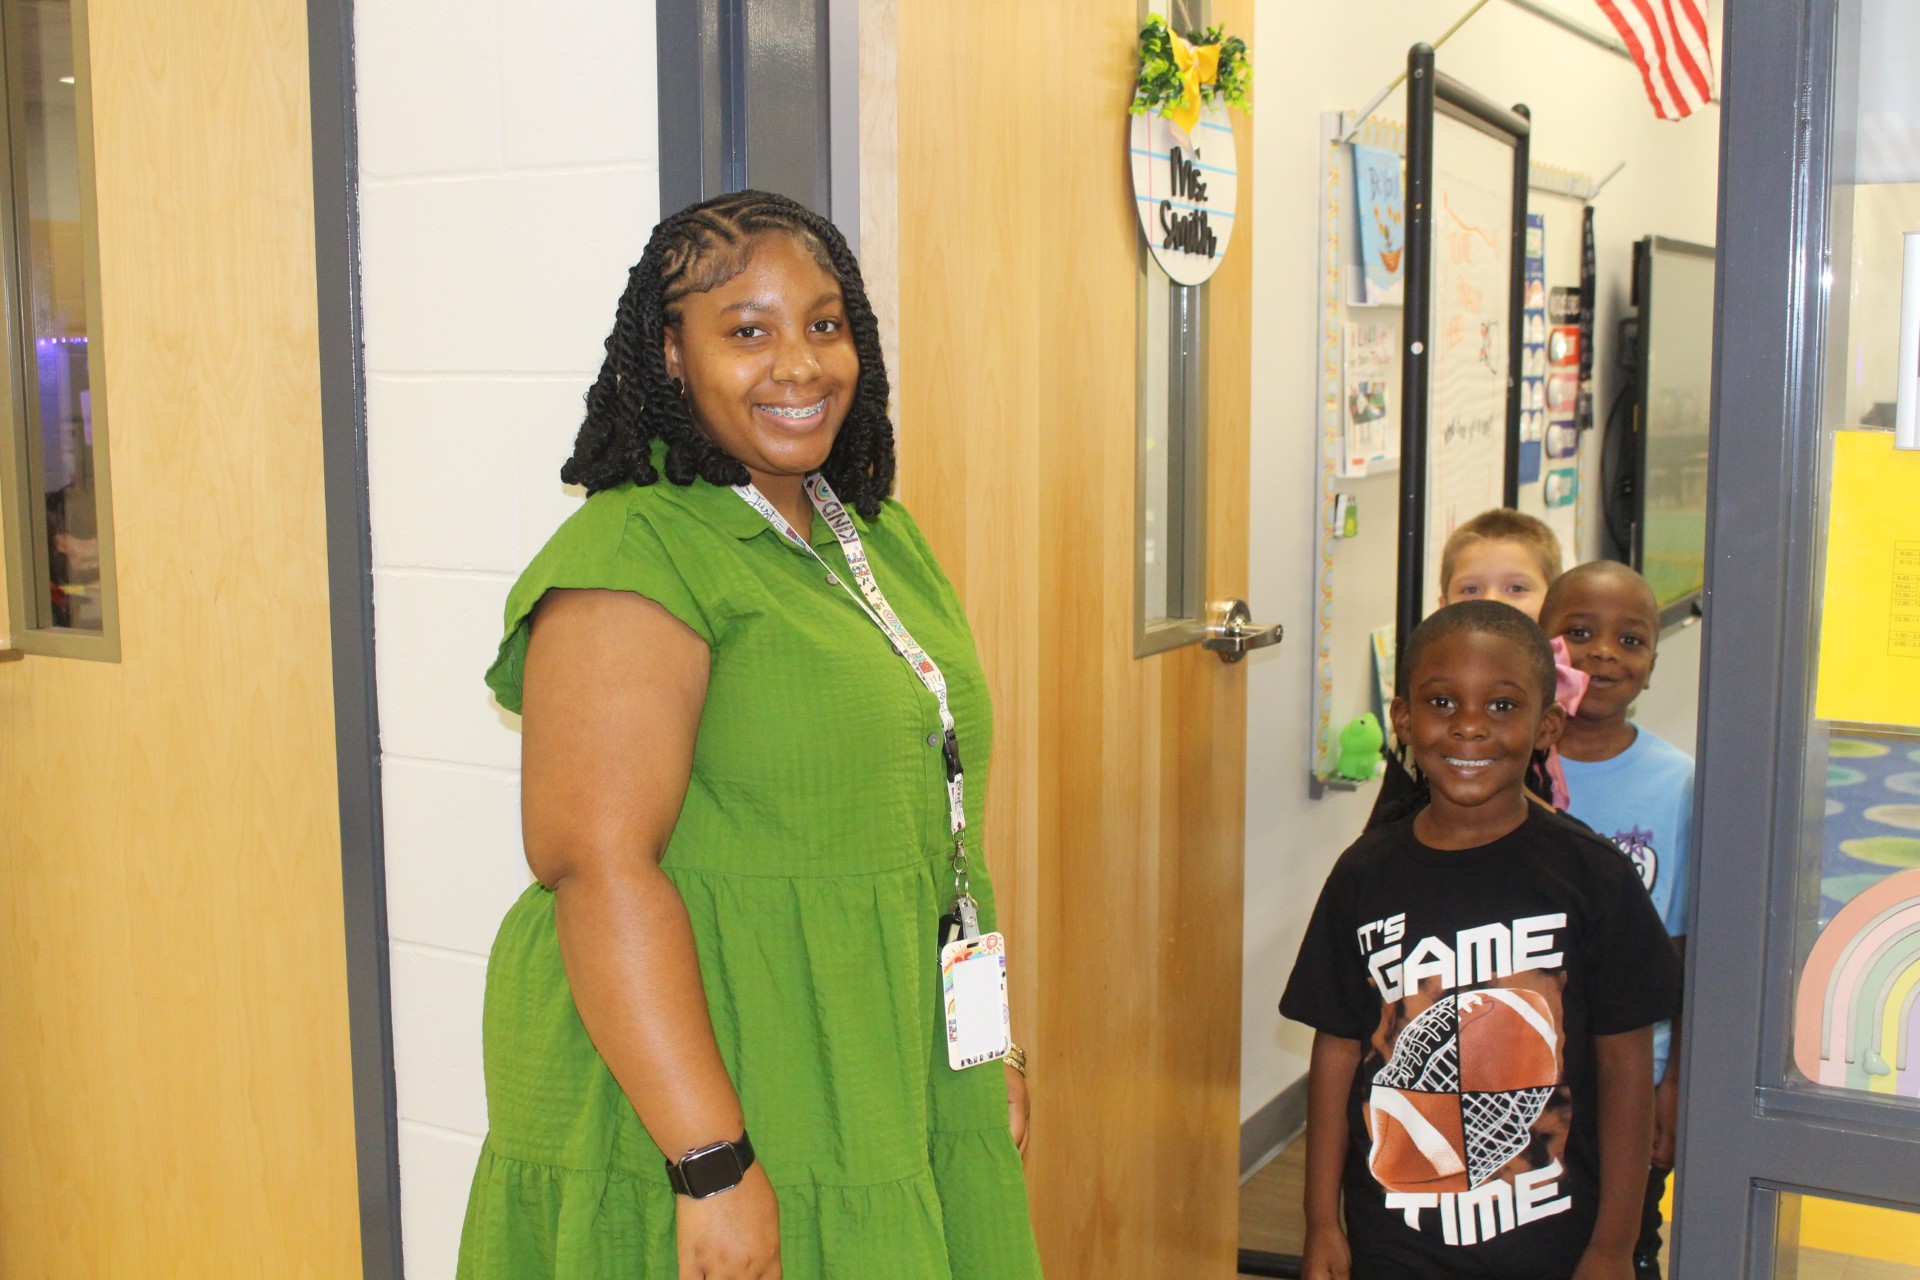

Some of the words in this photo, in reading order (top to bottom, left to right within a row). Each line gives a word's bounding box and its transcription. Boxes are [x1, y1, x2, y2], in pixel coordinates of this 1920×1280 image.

[1159, 199, 1218, 259] Smith
[822, 501, 859, 545] KIND
[883, 609, 920, 650] KIND
[911, 650, 935, 674] BE
[1356, 912, 1406, 955] IT'S
[1367, 912, 1567, 1005] GAME
[1384, 1157, 1572, 1247] TIME
